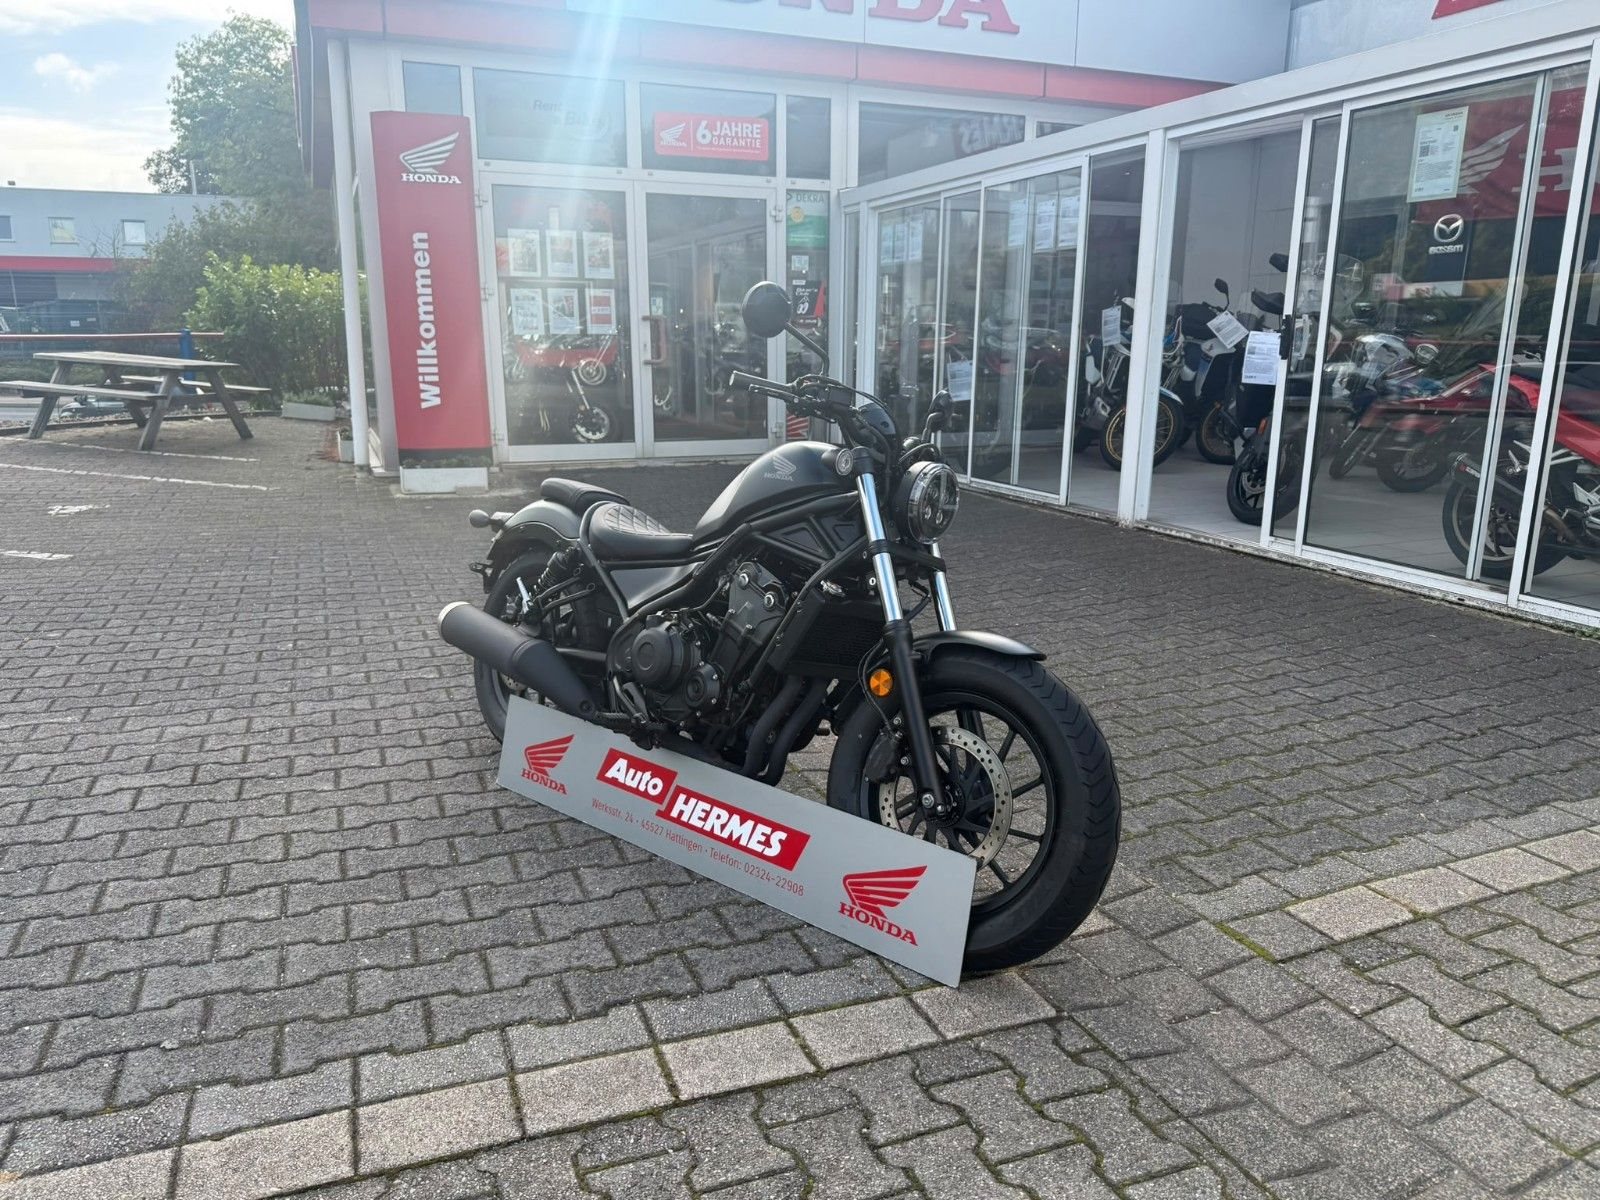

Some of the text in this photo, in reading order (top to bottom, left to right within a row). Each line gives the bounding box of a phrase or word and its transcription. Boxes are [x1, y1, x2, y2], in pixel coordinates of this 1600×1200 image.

[696, 120, 763, 145] 6 JAHRE
[712, 136, 762, 149] GARANTIE
[400, 172, 462, 184] HONDA
[412, 232, 442, 409] Willkommen
[763, 472, 794, 481] HONDA
[521, 767, 568, 795] HONDA
[604, 757, 788, 857] Auto HERMES
[624, 812, 634, 824] 24
[641, 818, 665, 836] 45527
[665, 828, 703, 852] Hattingen
[709, 847, 742, 870] Telefon:
[744, 862, 805, 897] 02324-22908
[838, 901, 918, 947] HONDA
